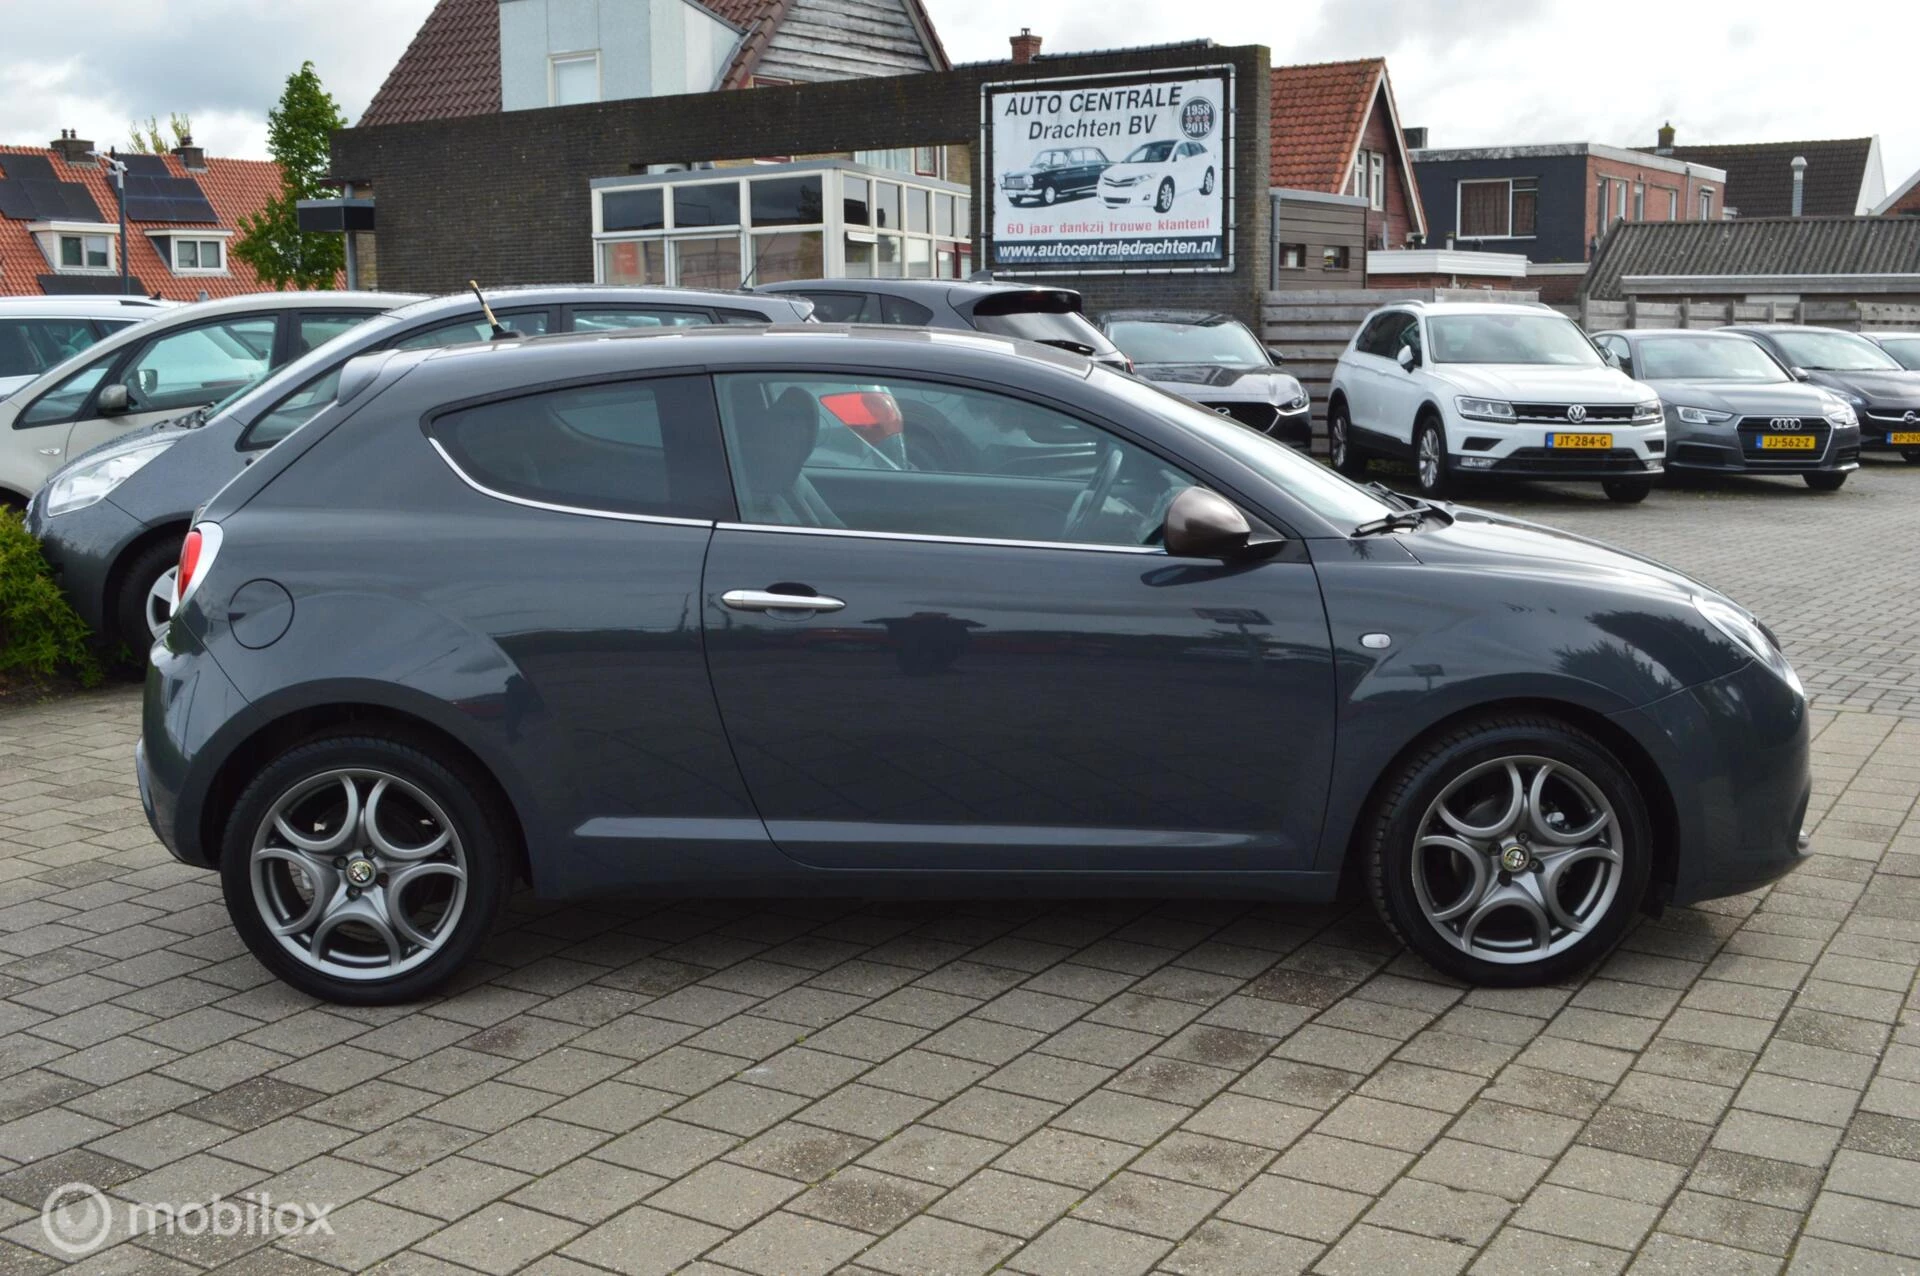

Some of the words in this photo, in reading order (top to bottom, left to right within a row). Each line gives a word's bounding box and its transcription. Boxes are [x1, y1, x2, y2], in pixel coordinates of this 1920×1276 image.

[1005, 94, 1062, 116] AUTO
[1069, 86, 1183, 112] CENTRALE
[1186, 104, 1210, 116] 1958
[1029, 119, 1121, 140] Drachten
[1128, 114, 1157, 135] BV
[1185, 121, 1210, 133] 2018
[1007, 223, 1024, 234] 60
[1030, 223, 1054, 235] jaar
[1060, 221, 1104, 234] dankzij
[1109, 221, 1152, 232] trouwe
[1158, 218, 1210, 231] klanten!
[999, 237, 1217, 257] www.autocentraledrachten.nl
[1558, 435, 1607, 447] JT-284-G
[1767, 437, 1810, 448] JJ-562-Z
